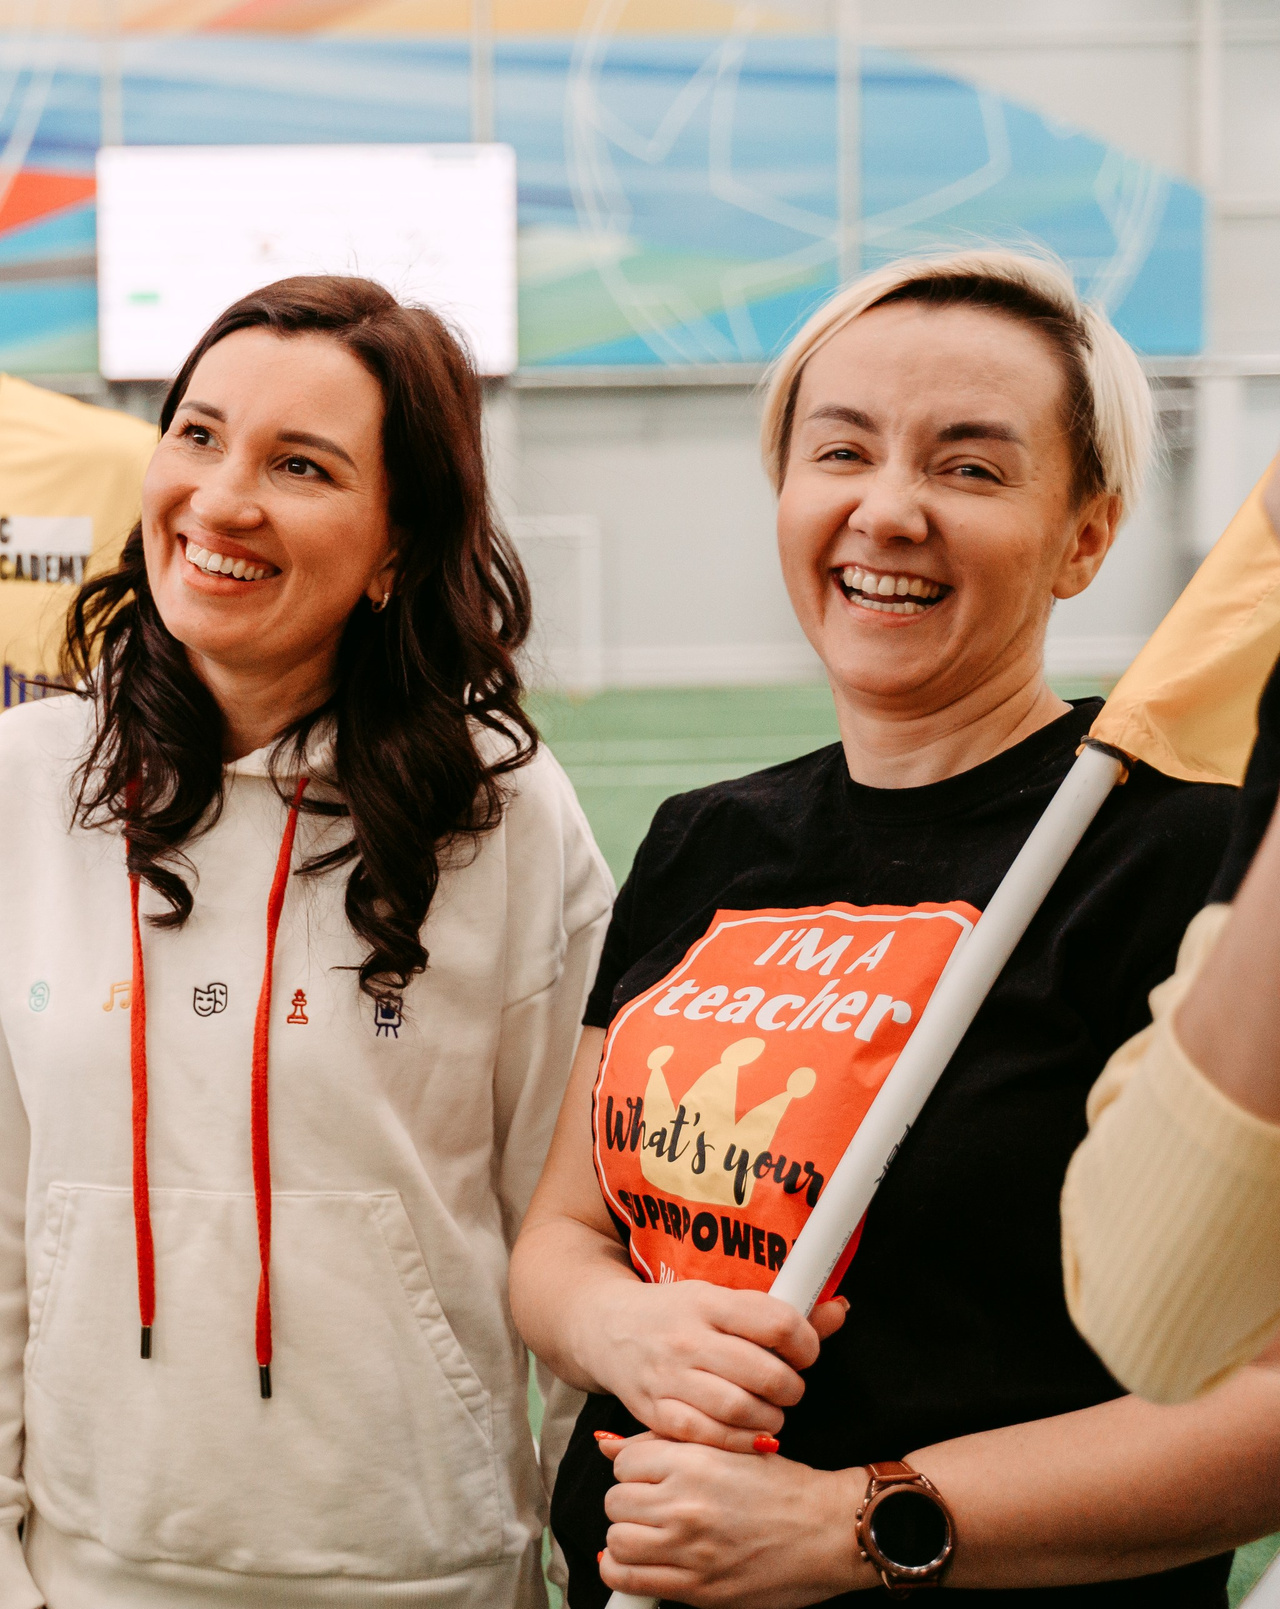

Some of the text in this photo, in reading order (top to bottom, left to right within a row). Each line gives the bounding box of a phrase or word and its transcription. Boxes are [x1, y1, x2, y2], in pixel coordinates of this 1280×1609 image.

[753, 927, 897, 976] I'M A
[653, 978, 913, 1043] teacher
[605, 1095, 825, 1209] What's your
[617, 1189, 799, 1272] SUPERPOWER
